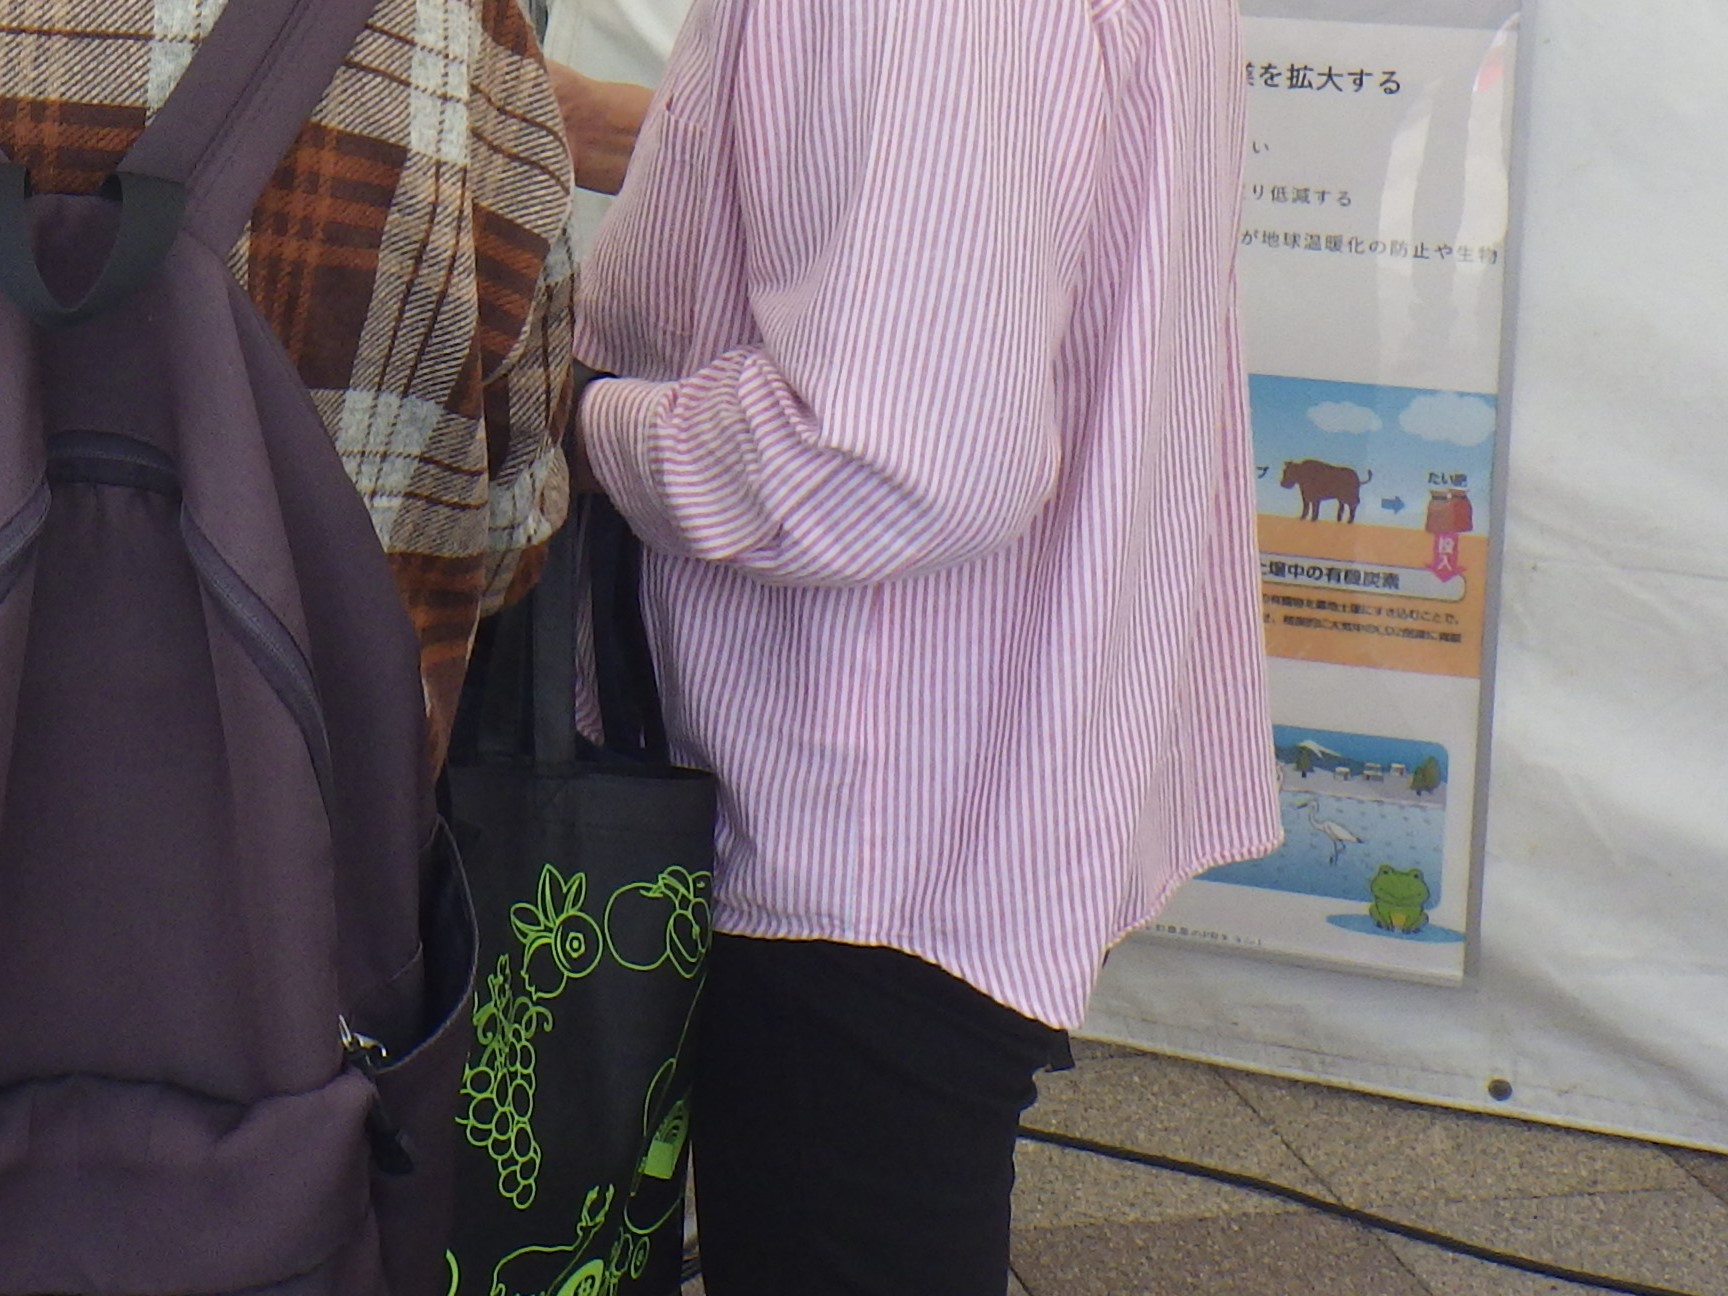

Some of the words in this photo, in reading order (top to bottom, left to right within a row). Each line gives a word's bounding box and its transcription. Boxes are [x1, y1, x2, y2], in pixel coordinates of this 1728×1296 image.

[1242, 184, 1353, 208] り低減する
